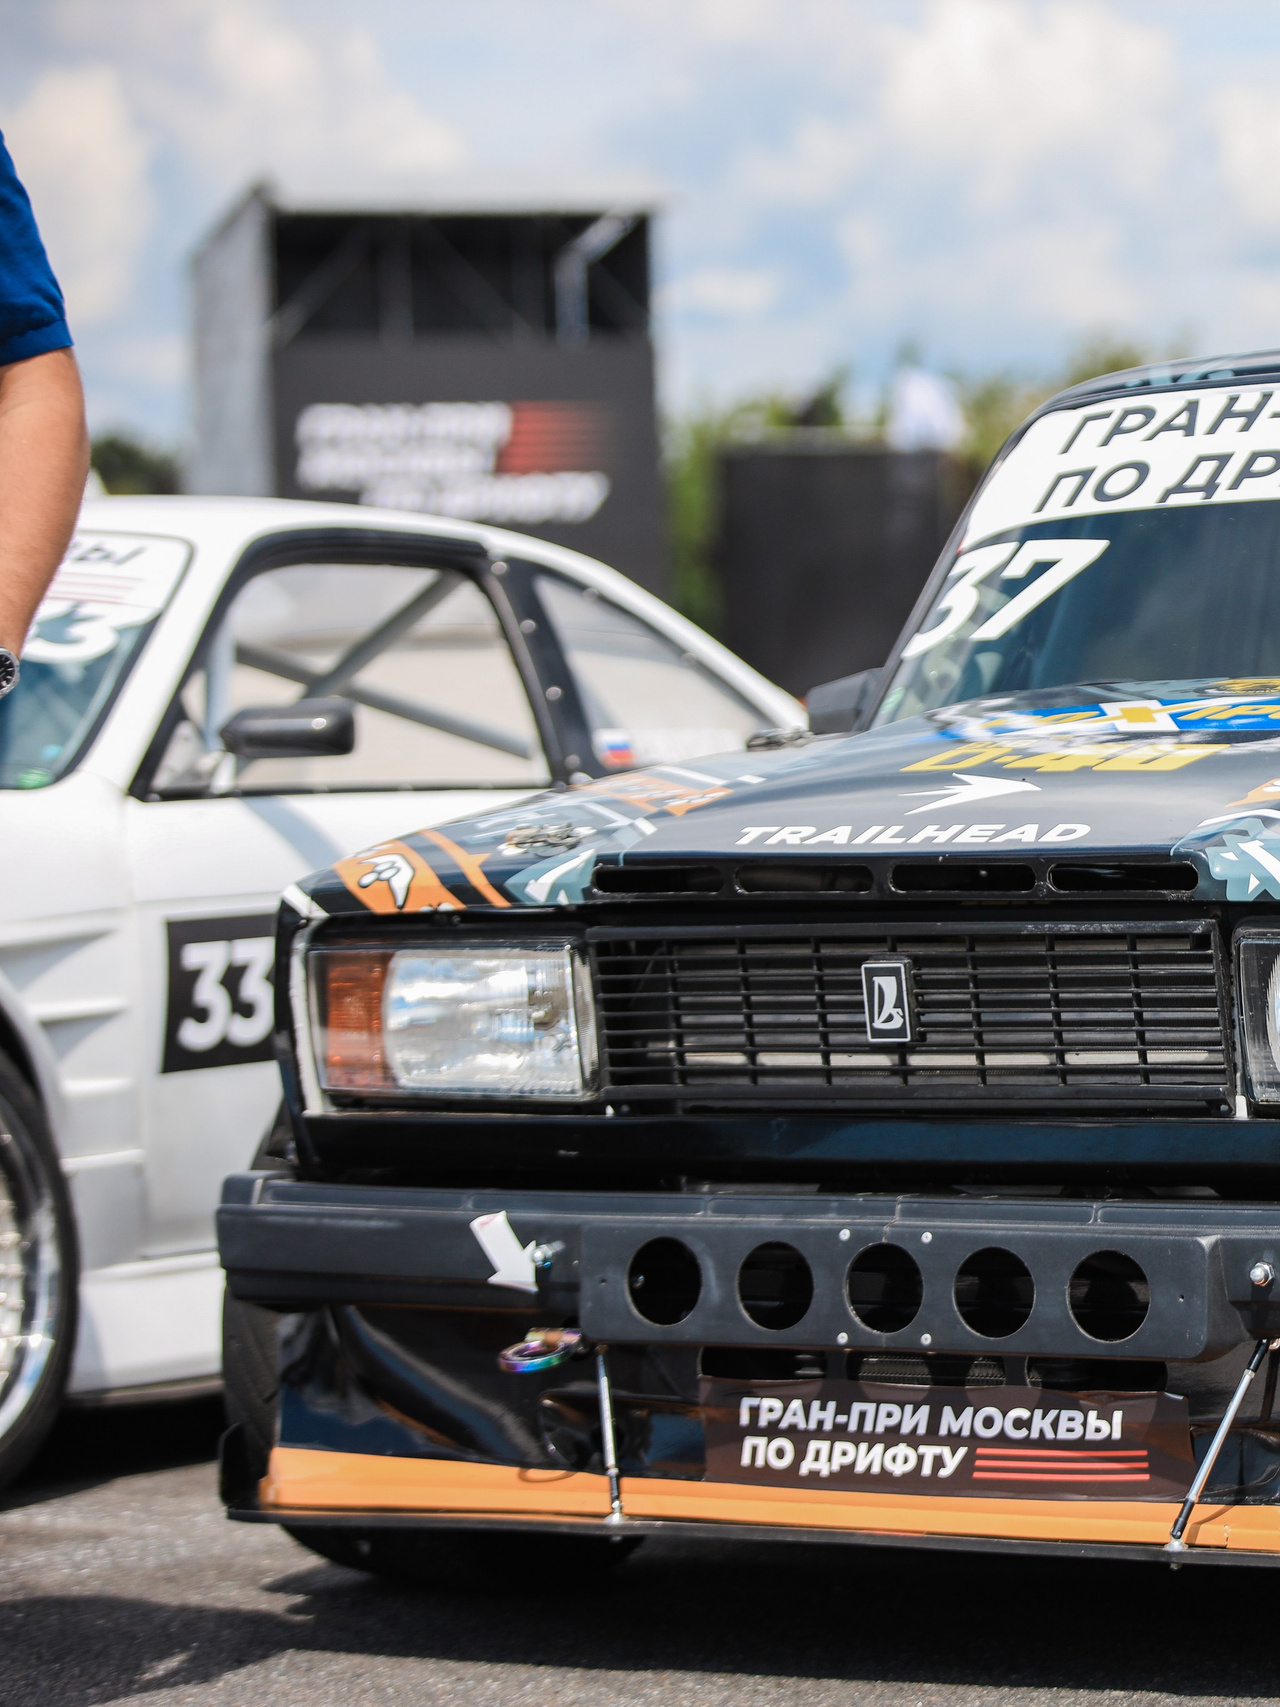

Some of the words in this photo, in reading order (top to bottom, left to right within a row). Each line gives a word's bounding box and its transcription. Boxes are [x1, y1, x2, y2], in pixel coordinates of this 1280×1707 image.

[1033, 461, 1150, 514] ПО
[901, 538, 1110, 660] 37
[734, 823, 1092, 846] TRAILHEAD
[177, 935, 276, 1053] 33
[738, 1396, 932, 1437] ГРАН-ПРИ
[937, 1405, 1123, 1442] МОСКВЫ
[740, 1435, 795, 1469] ПО
[799, 1438, 968, 1479] ДРИФТУ
